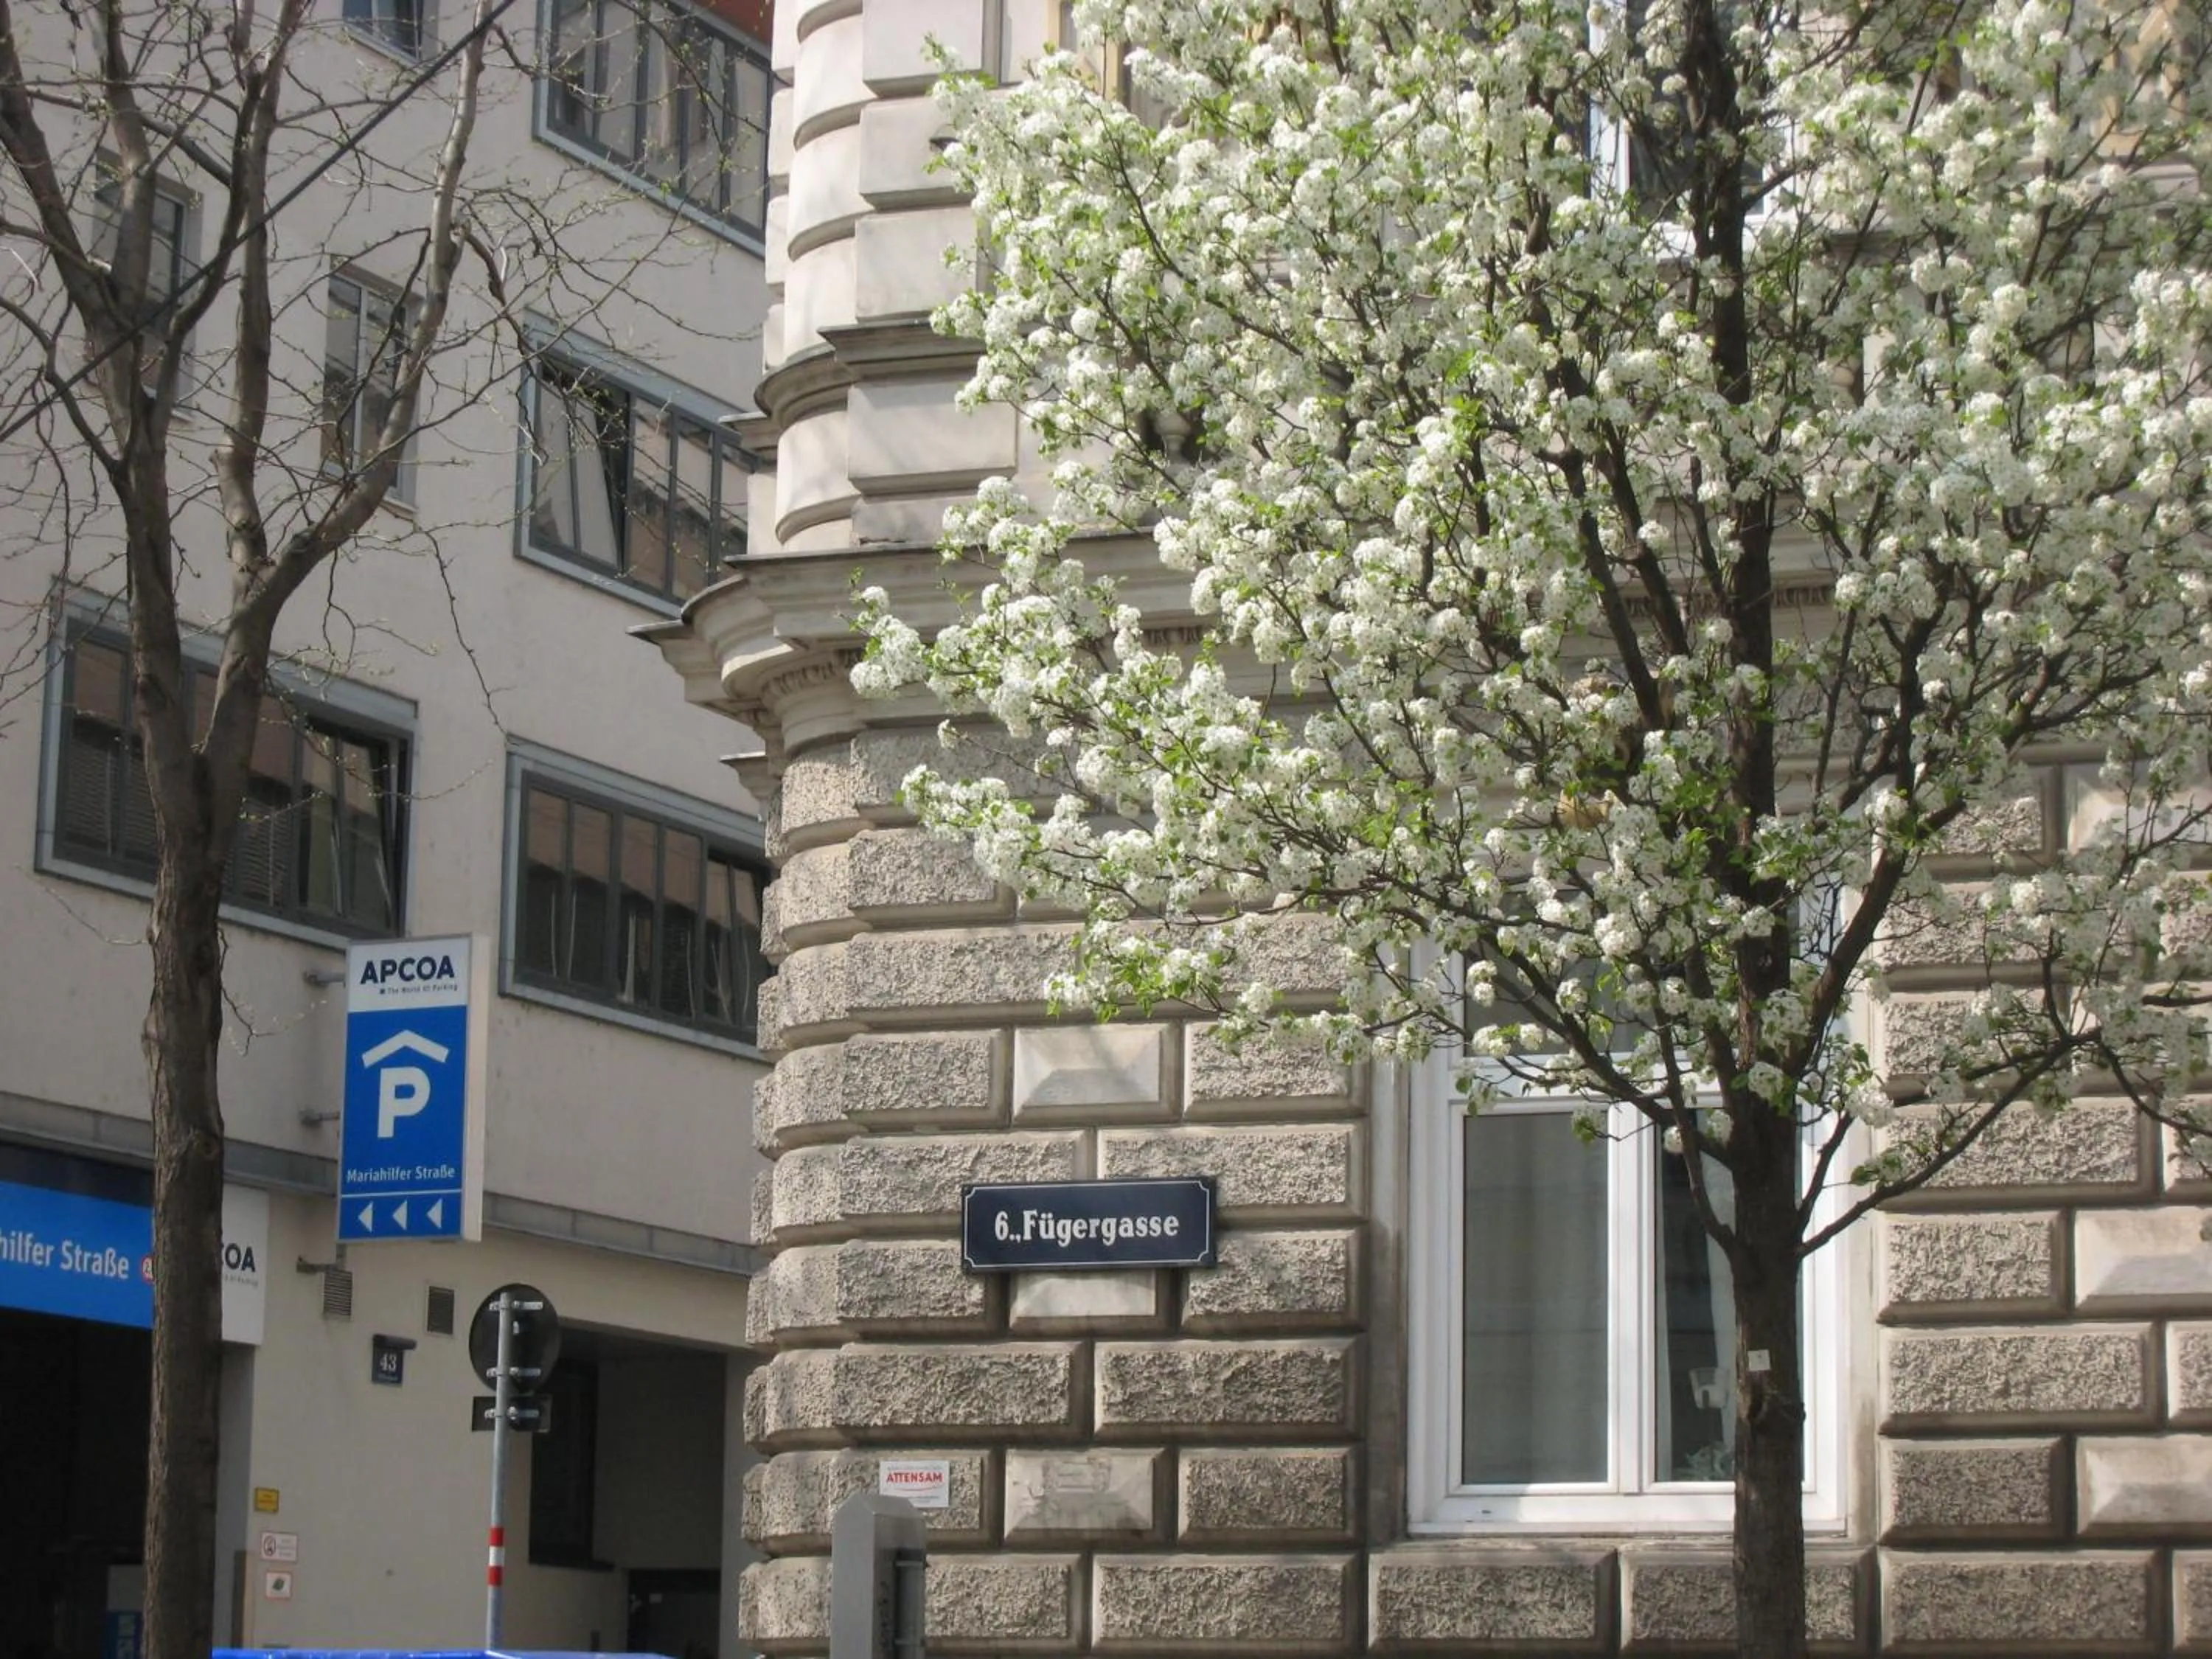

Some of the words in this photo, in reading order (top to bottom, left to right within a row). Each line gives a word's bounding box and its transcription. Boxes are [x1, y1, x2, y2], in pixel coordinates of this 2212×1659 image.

[360, 955, 455, 984] APCOA
[378, 1066, 431, 1138] P
[347, 1166, 412, 1183] Mariahilfer
[414, 1164, 455, 1180] Straße
[60, 1239, 129, 1280] Straße
[380, 1353, 397, 1372] 43
[886, 1471, 943, 1484] ATTENSAM
